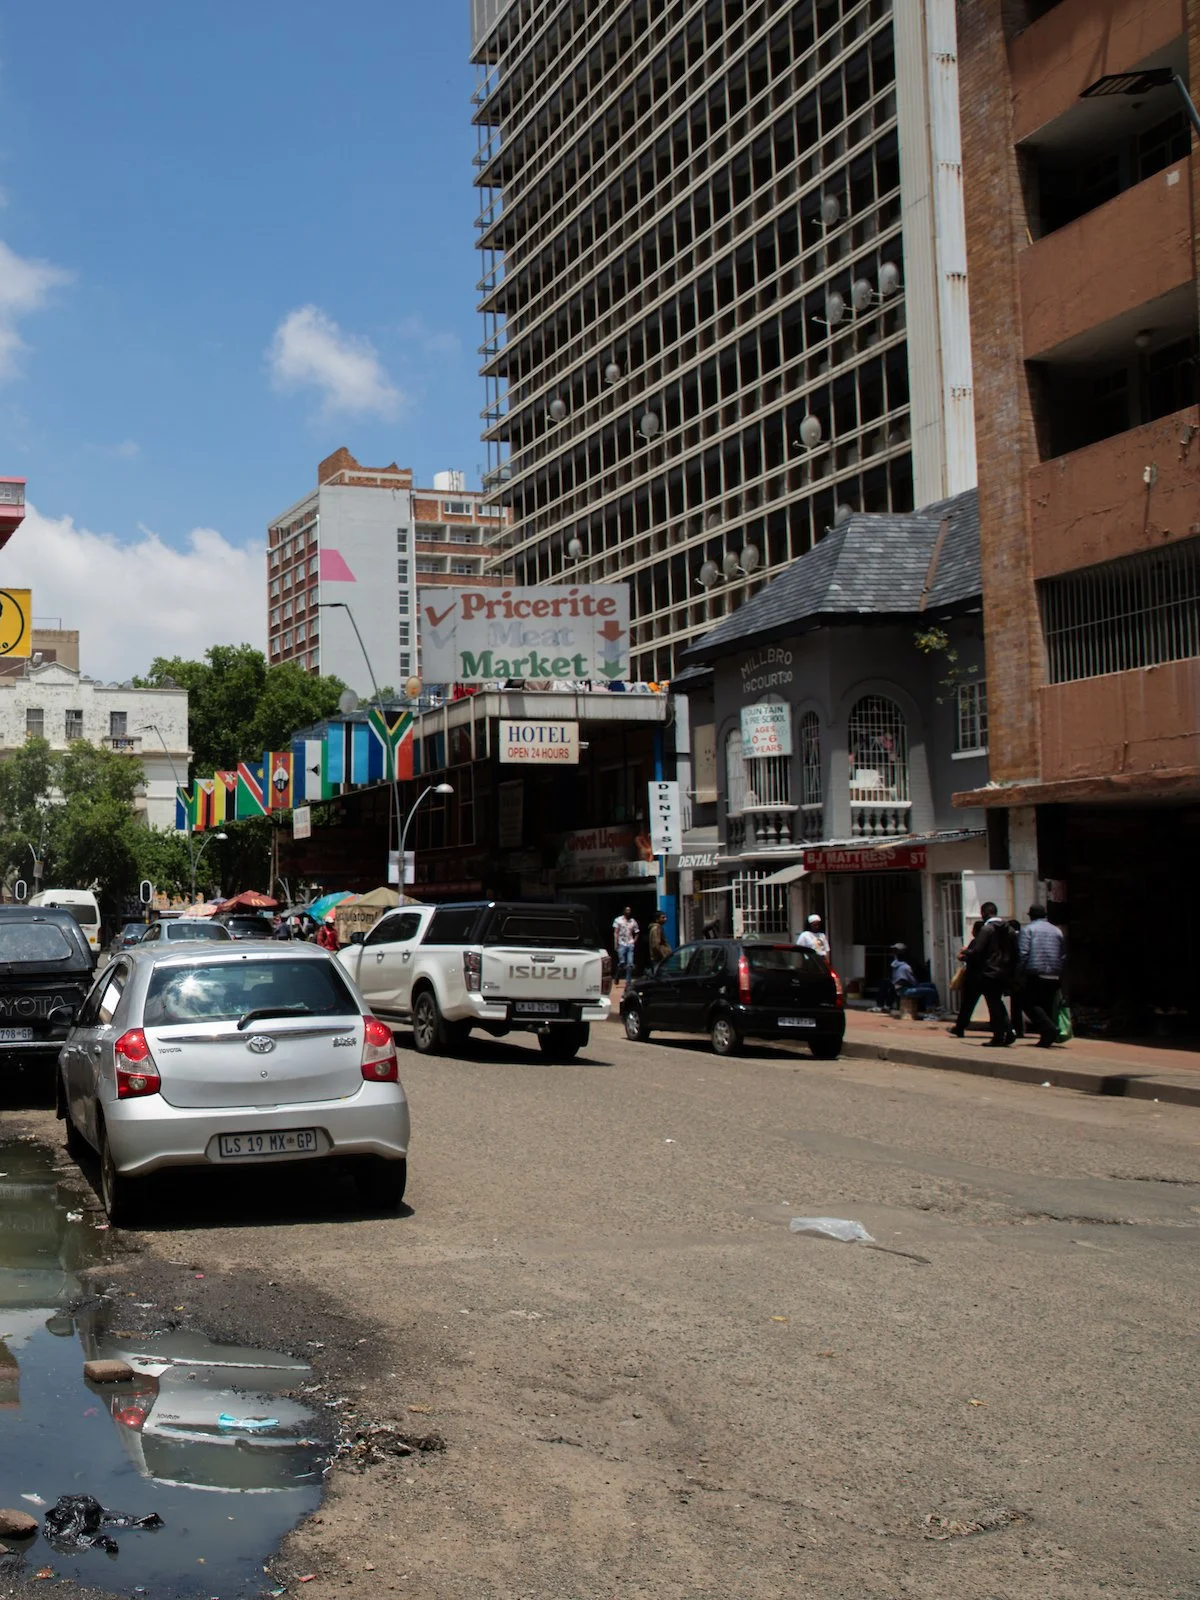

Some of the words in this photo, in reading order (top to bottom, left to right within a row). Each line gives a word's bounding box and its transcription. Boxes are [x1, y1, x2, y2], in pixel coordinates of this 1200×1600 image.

[461, 588, 617, 620] Pricerite
[488, 621, 575, 648] Meat
[460, 650, 589, 679] Market
[740, 648, 793, 679] MILLBRO
[751, 671, 783, 691] COURT
[508, 726, 571, 743] HOTEL
[508, 747, 529, 758] OPEN
[531, 747, 540, 758] 24
[542, 747, 569, 758] HOURS
[658, 783, 673, 852] DENTIST
[677, 854, 712, 868] DENTAL
[826, 849, 897, 864] MATTRESS
[509, 965, 577, 980] ISUZU
[21, 1028, 33, 1038] GP
[225, 1138, 241, 1153] LS
[247, 1136, 263, 1152] 19
[269, 1135, 286, 1151] MX
[297, 1133, 312, 1148] GP
